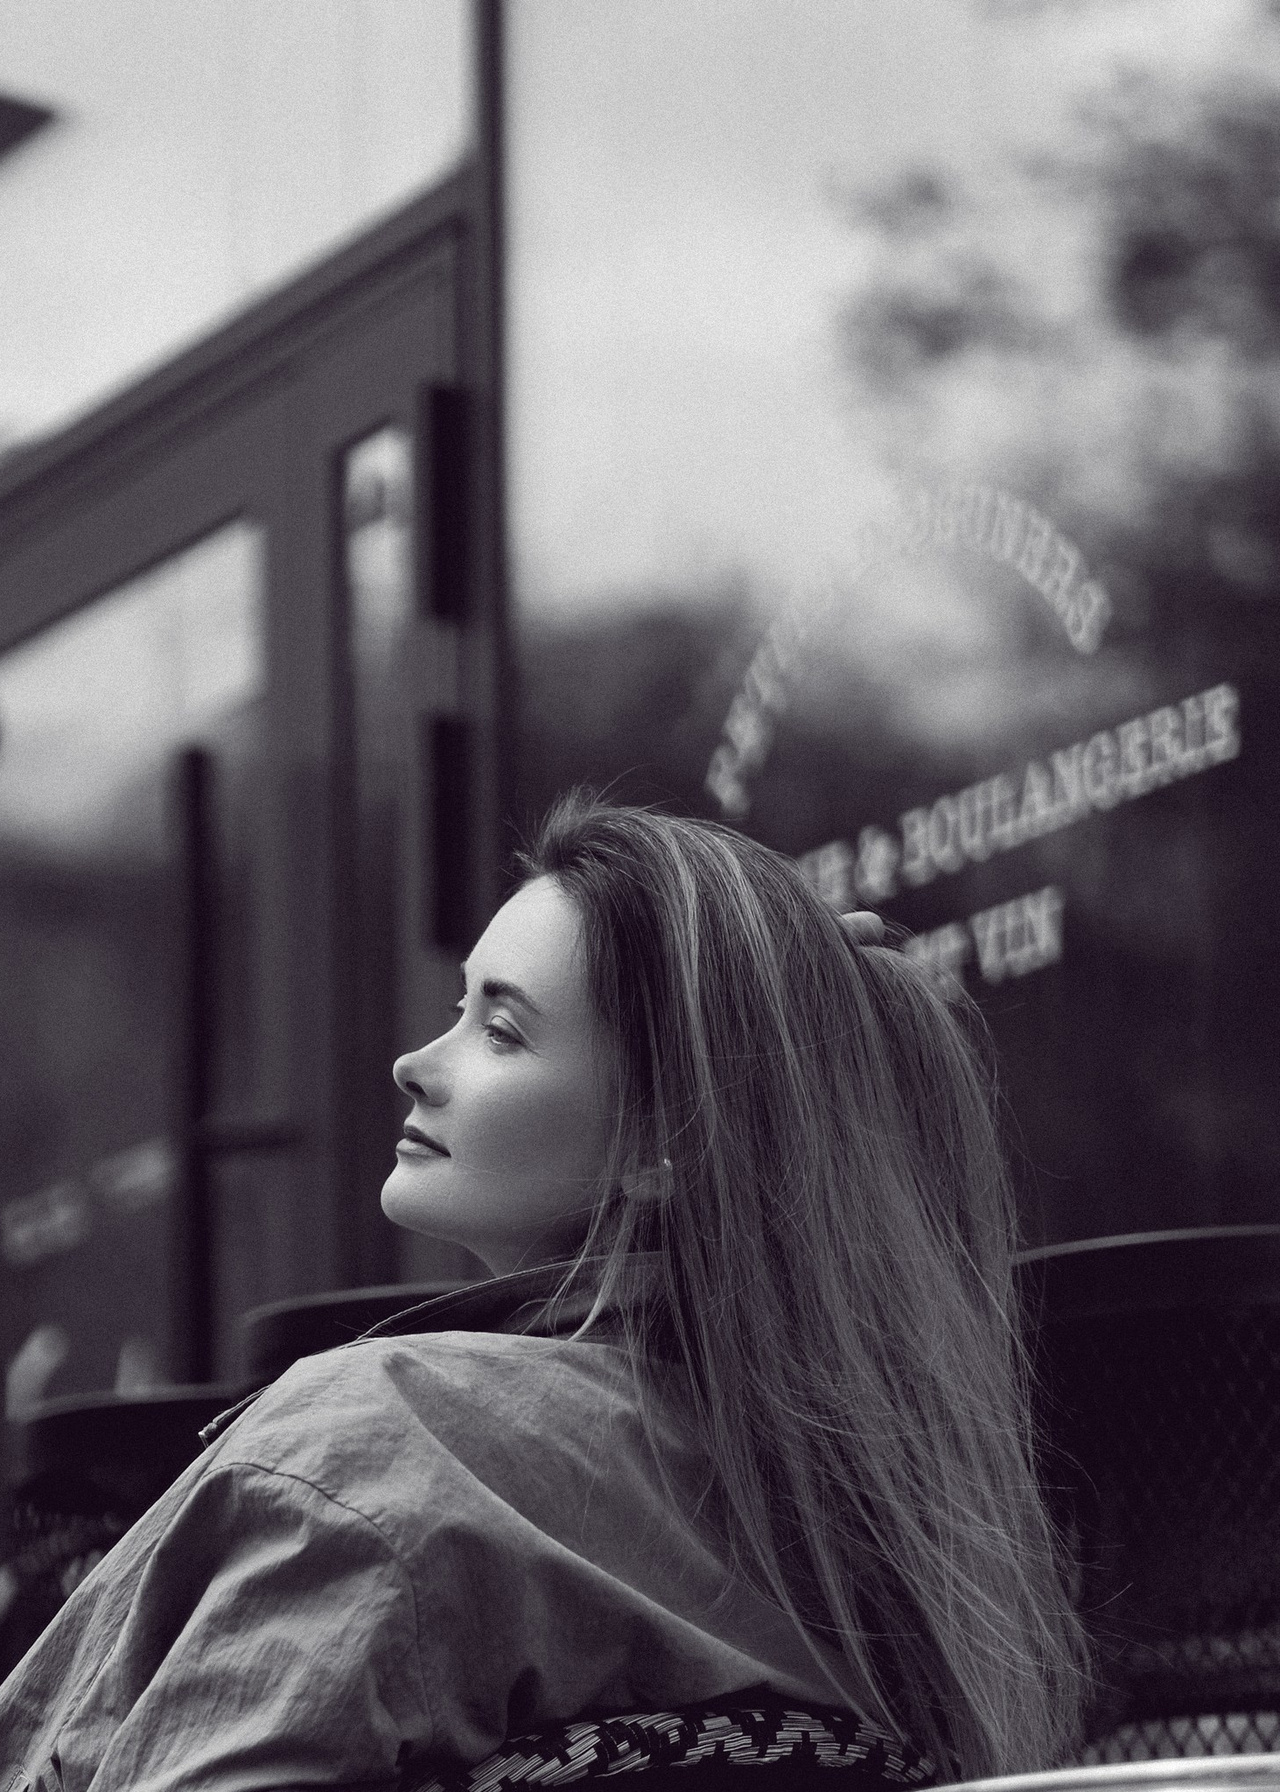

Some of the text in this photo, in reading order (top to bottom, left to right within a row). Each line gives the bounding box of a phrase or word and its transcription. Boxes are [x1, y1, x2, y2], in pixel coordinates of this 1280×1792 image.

[854, 824, 900, 902] &
[900, 682, 1241, 886] BOULANGERIE
[971, 885, 1063, 984] VIN
